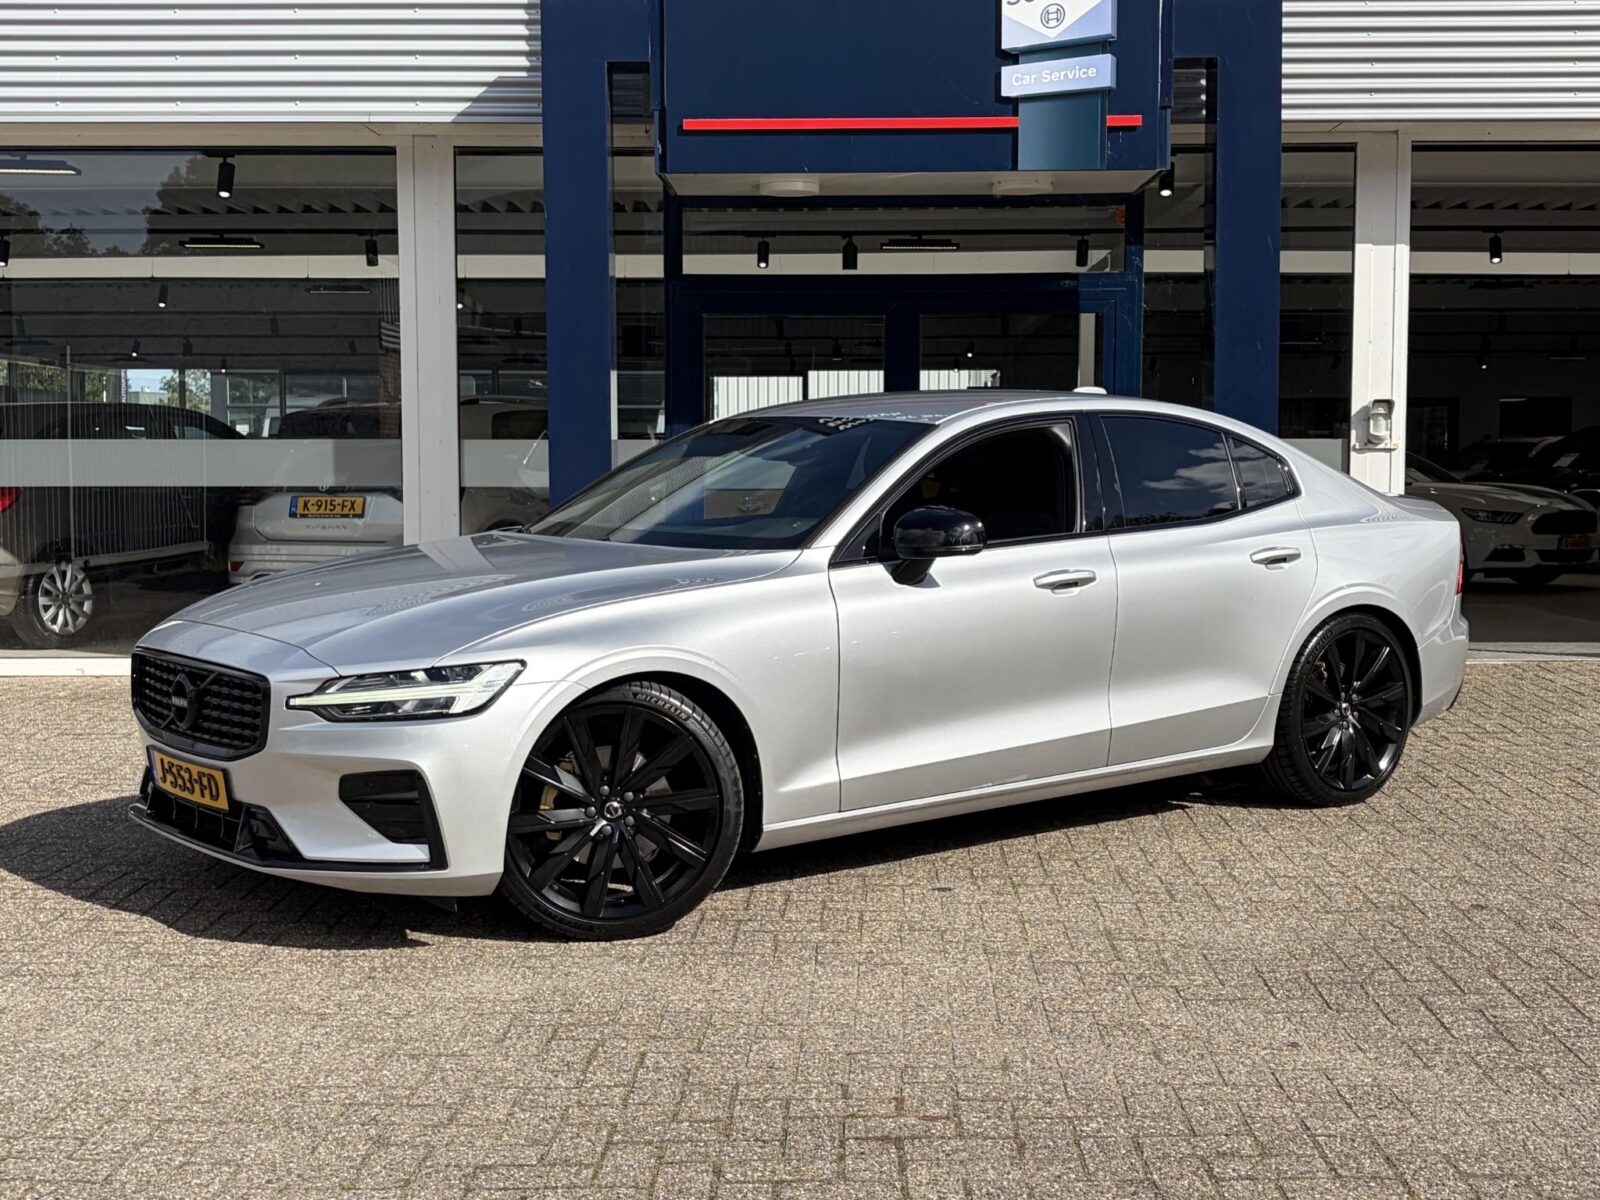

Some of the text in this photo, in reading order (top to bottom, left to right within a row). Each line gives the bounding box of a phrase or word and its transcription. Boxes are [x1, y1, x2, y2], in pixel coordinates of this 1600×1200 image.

[1012, 66, 1097, 86] Car Service
[303, 499, 357, 512] K-915-FX
[636, 693, 688, 720] MICHELIN
[160, 758, 220, 802] J-553-FD
